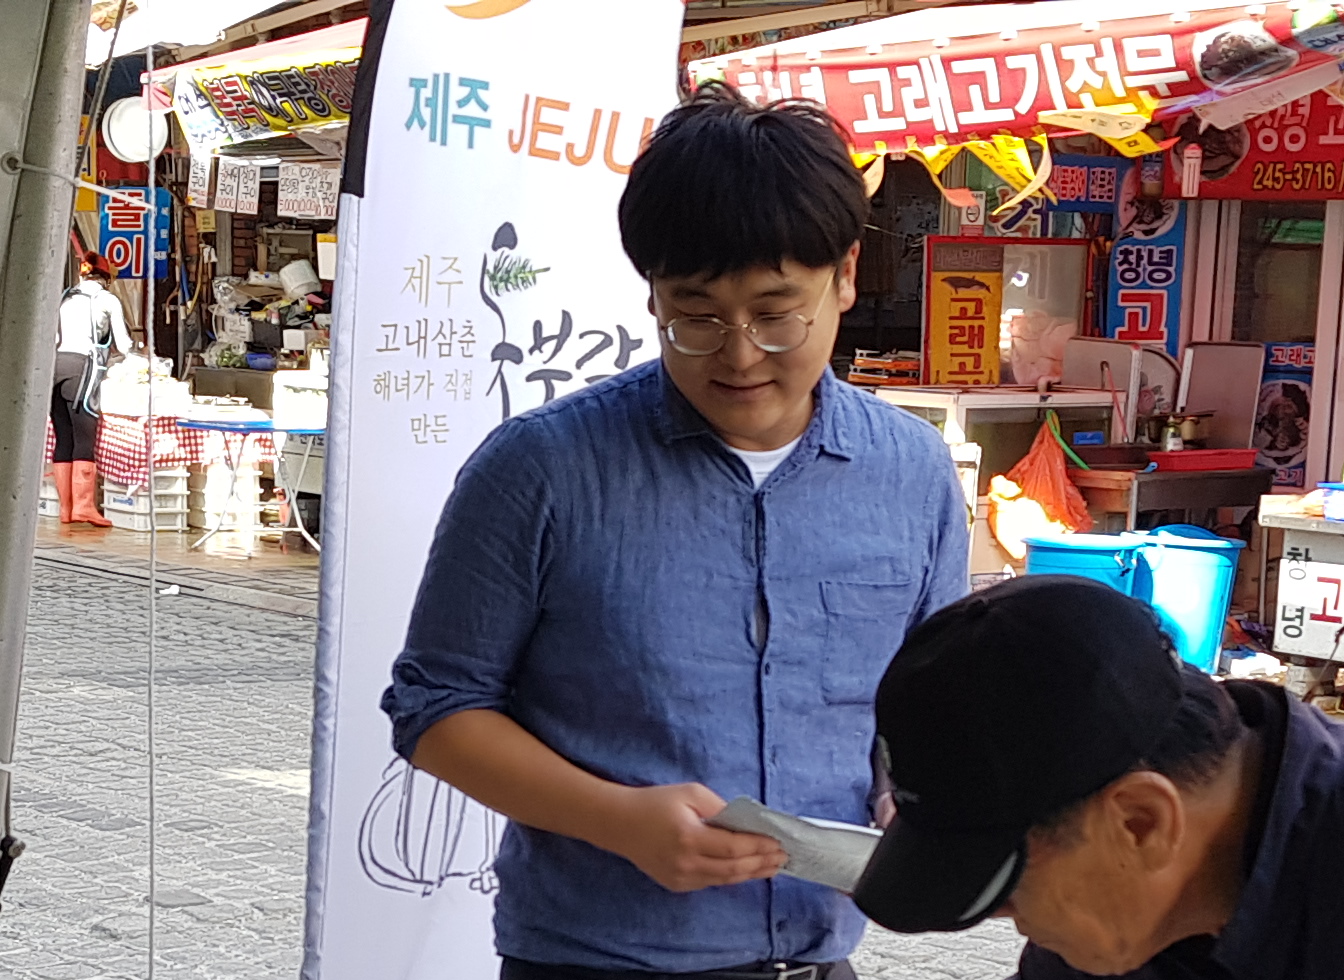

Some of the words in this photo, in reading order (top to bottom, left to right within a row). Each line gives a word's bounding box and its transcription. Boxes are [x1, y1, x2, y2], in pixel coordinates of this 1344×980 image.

[405, 72, 492, 149] 제주
[508, 93, 655, 175] JEJU
[1253, 162, 1335, 190] 245-3716
[401, 254, 464, 308] 제주
[1115, 245, 1177, 287] 창녕
[375, 317, 476, 359] 고내삼춘
[947, 297, 986, 384] 고래고
[1117, 288, 1168, 350] 고
[373, 369, 434, 402] 해녀가
[442, 368, 474, 402] 직접
[410, 412, 450, 445] 만든
[1280, 546, 1312, 639] 창녕
